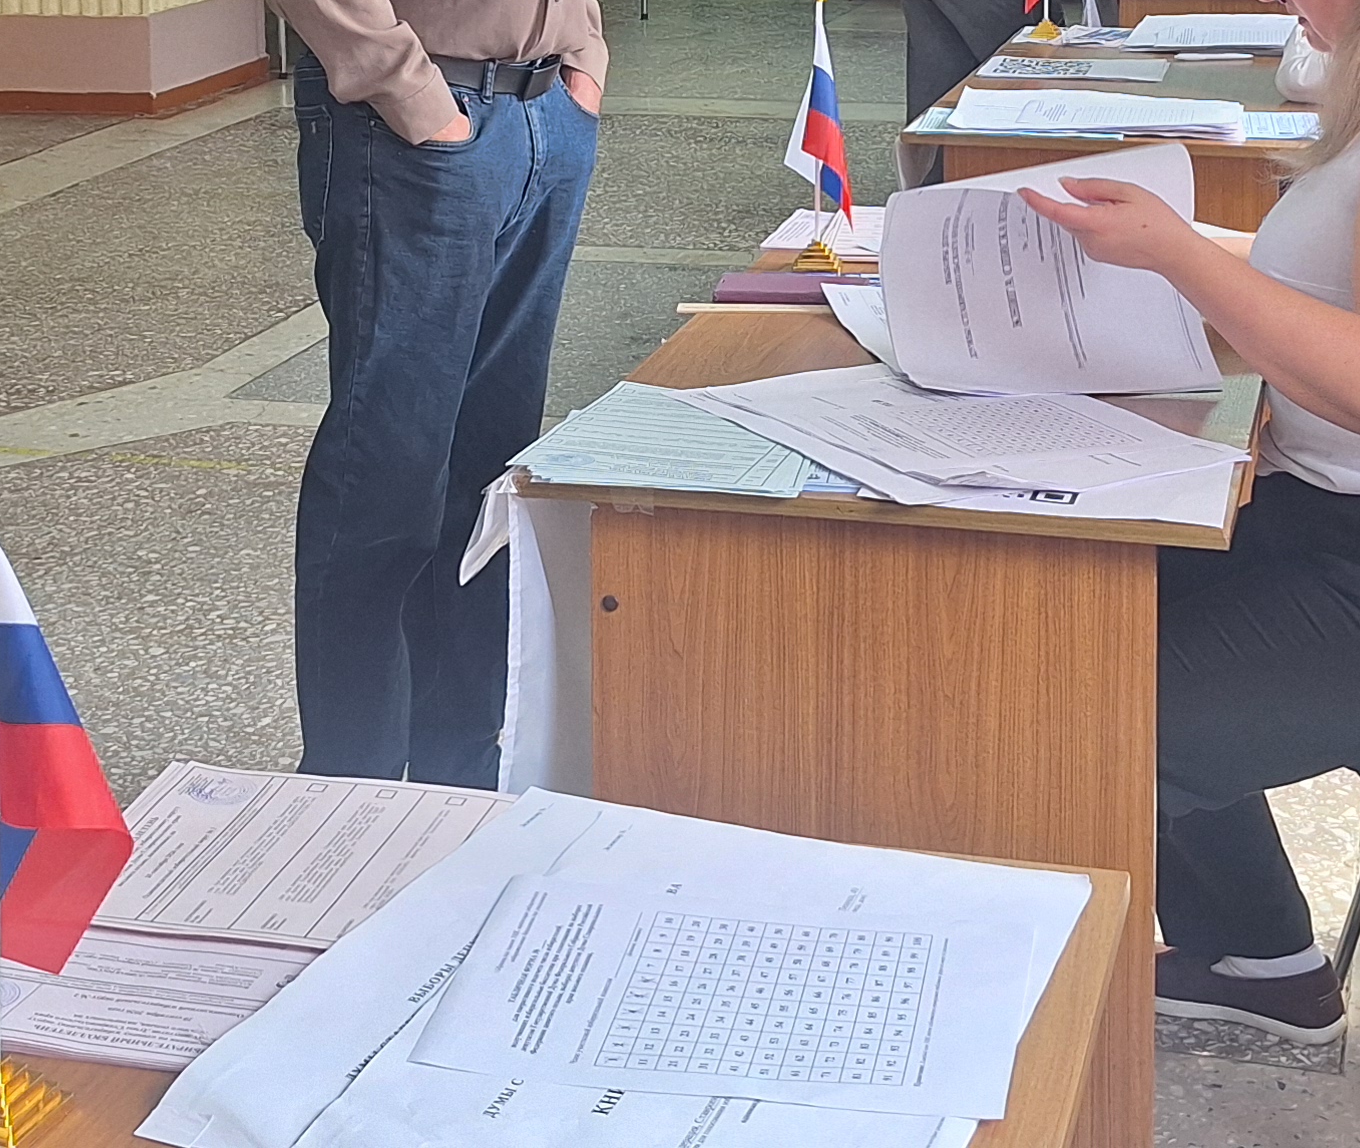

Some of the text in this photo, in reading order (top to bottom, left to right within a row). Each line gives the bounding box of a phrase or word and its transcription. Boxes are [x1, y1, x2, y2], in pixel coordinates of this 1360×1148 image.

[408, 963, 454, 1004] ВЫБОРЫ
[109, 1035, 205, 1054] БИРАТЕЛЬНЫЙ
[483, 1087, 517, 1119] ДУМЫ
